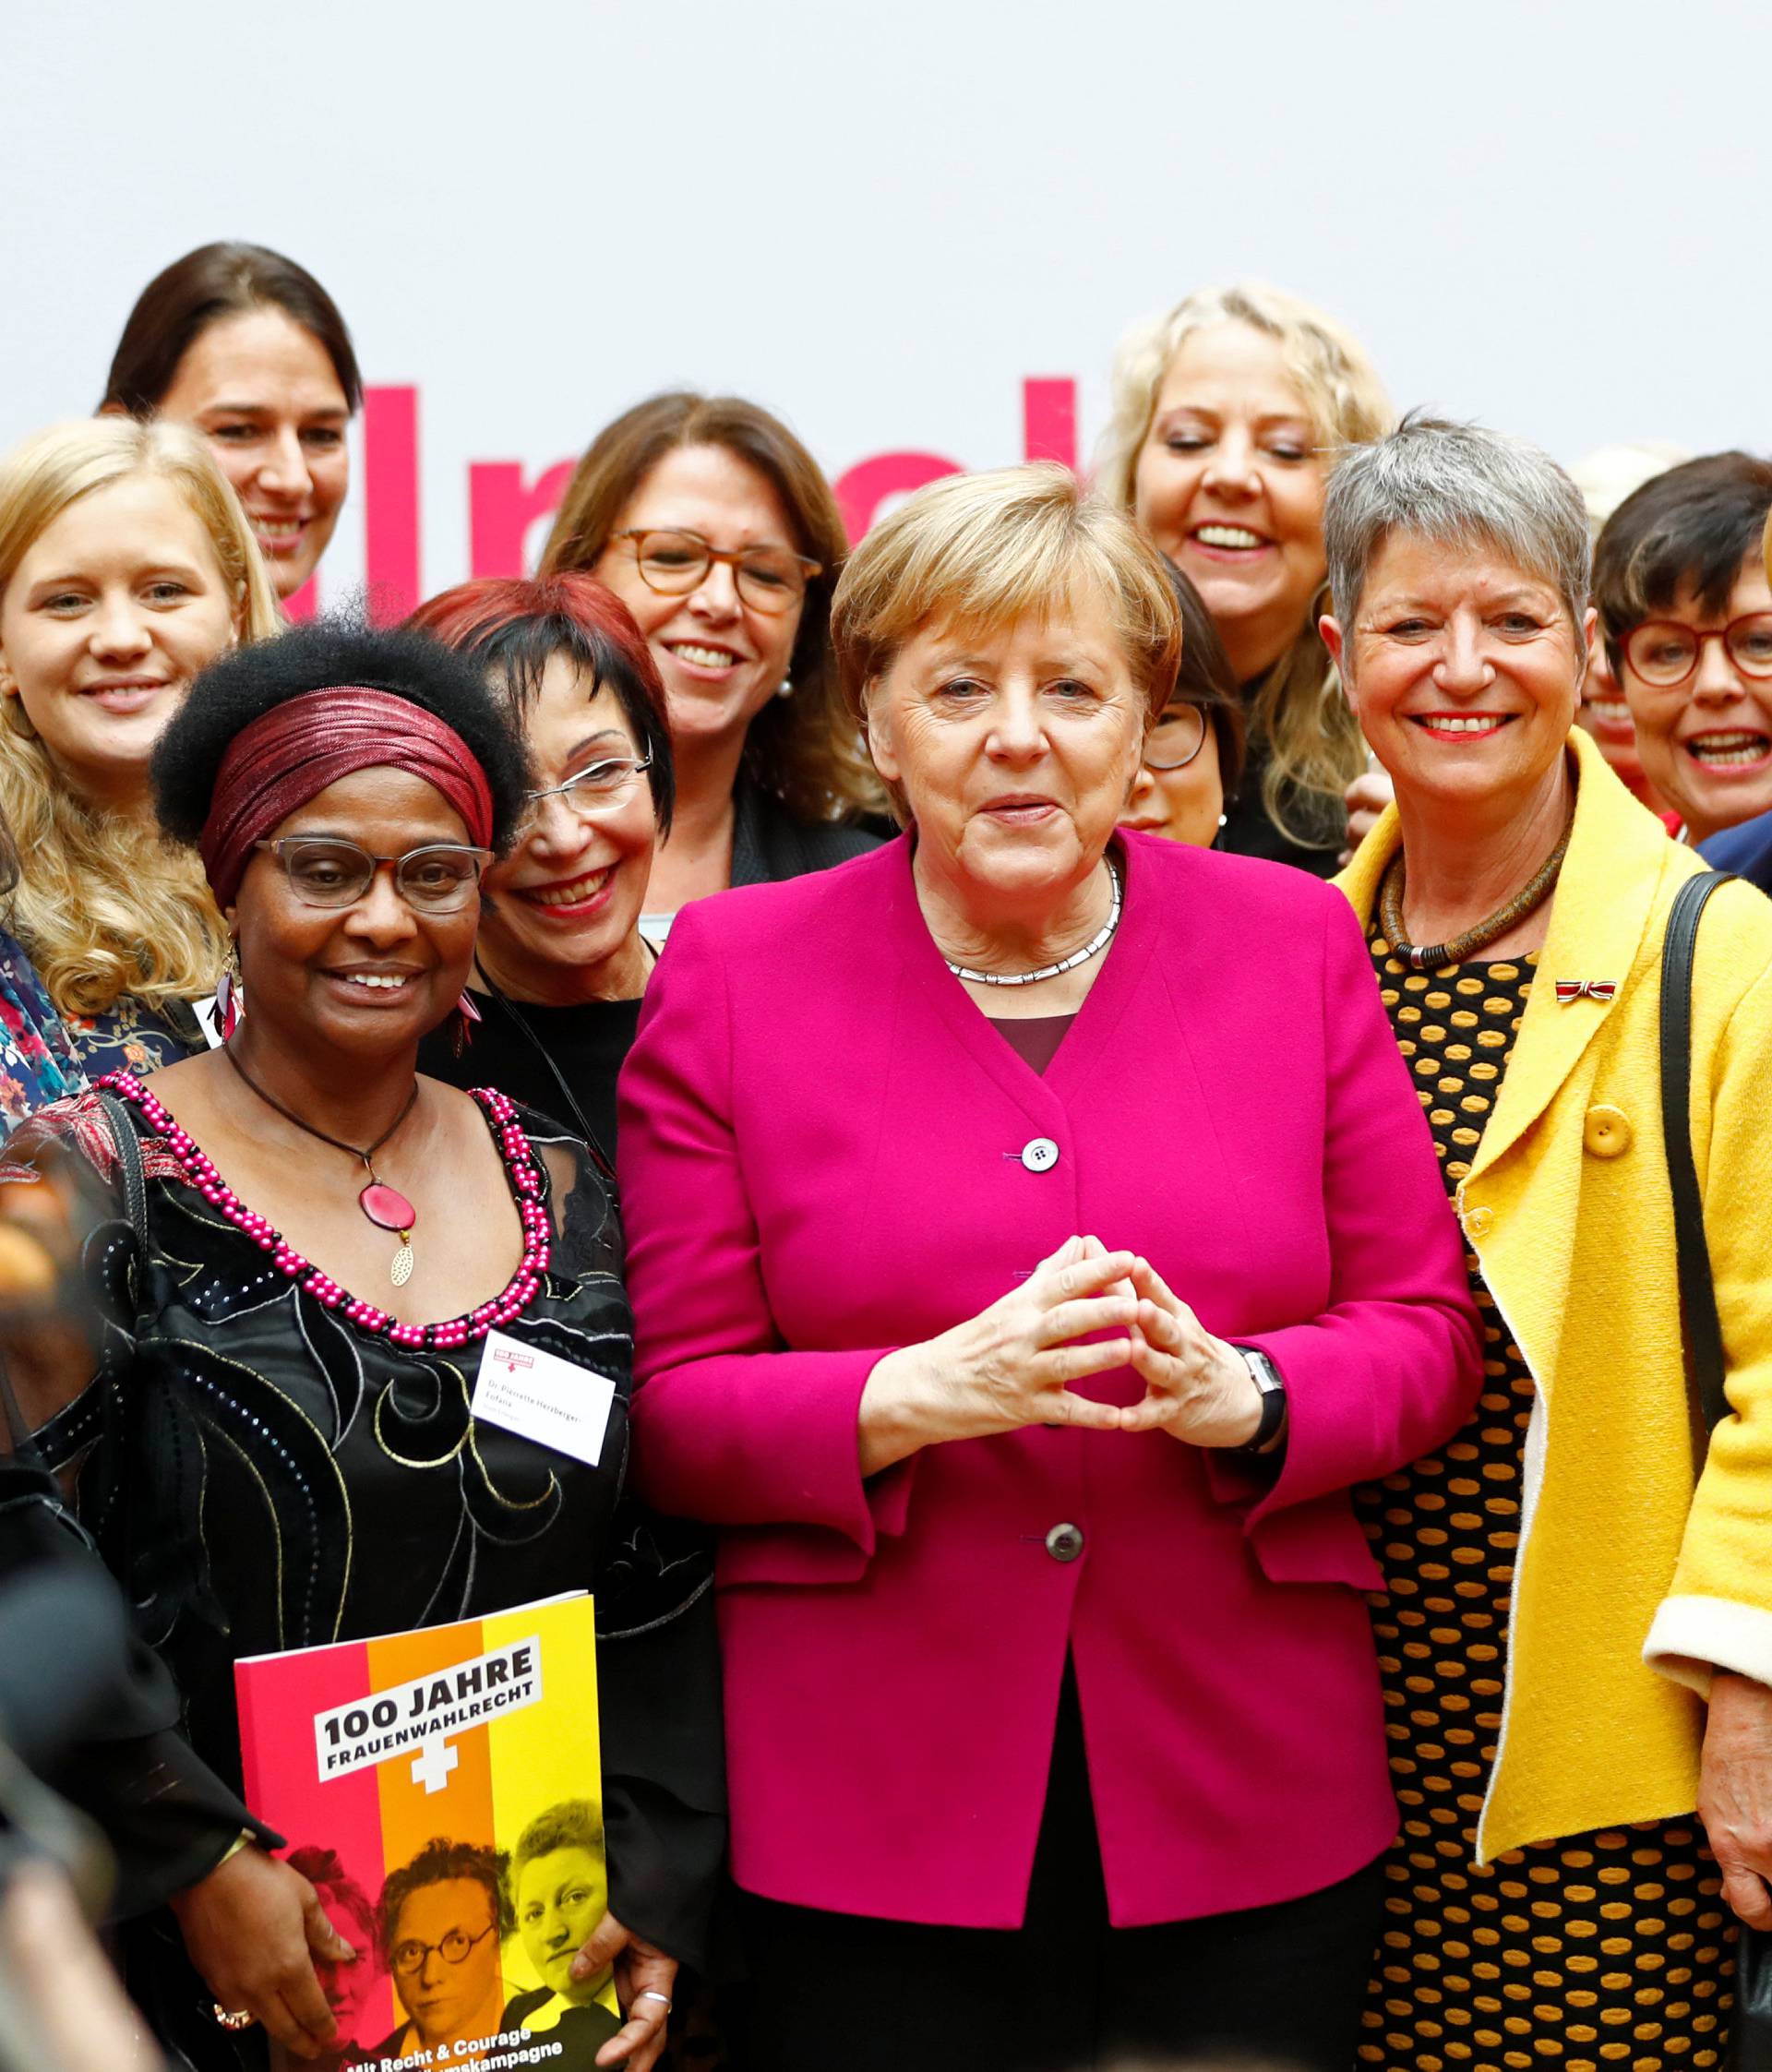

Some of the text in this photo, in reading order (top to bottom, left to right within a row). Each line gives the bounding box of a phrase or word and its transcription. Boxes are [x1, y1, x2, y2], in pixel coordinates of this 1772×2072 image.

[324, 1646, 533, 1746] 100 JAHRE
[326, 1680, 534, 1770] FRAUENWAHLRECHT
[379, 2048, 434, 2072] Recht
[436, 2043, 451, 2061] &
[452, 2028, 533, 2057] Courage
